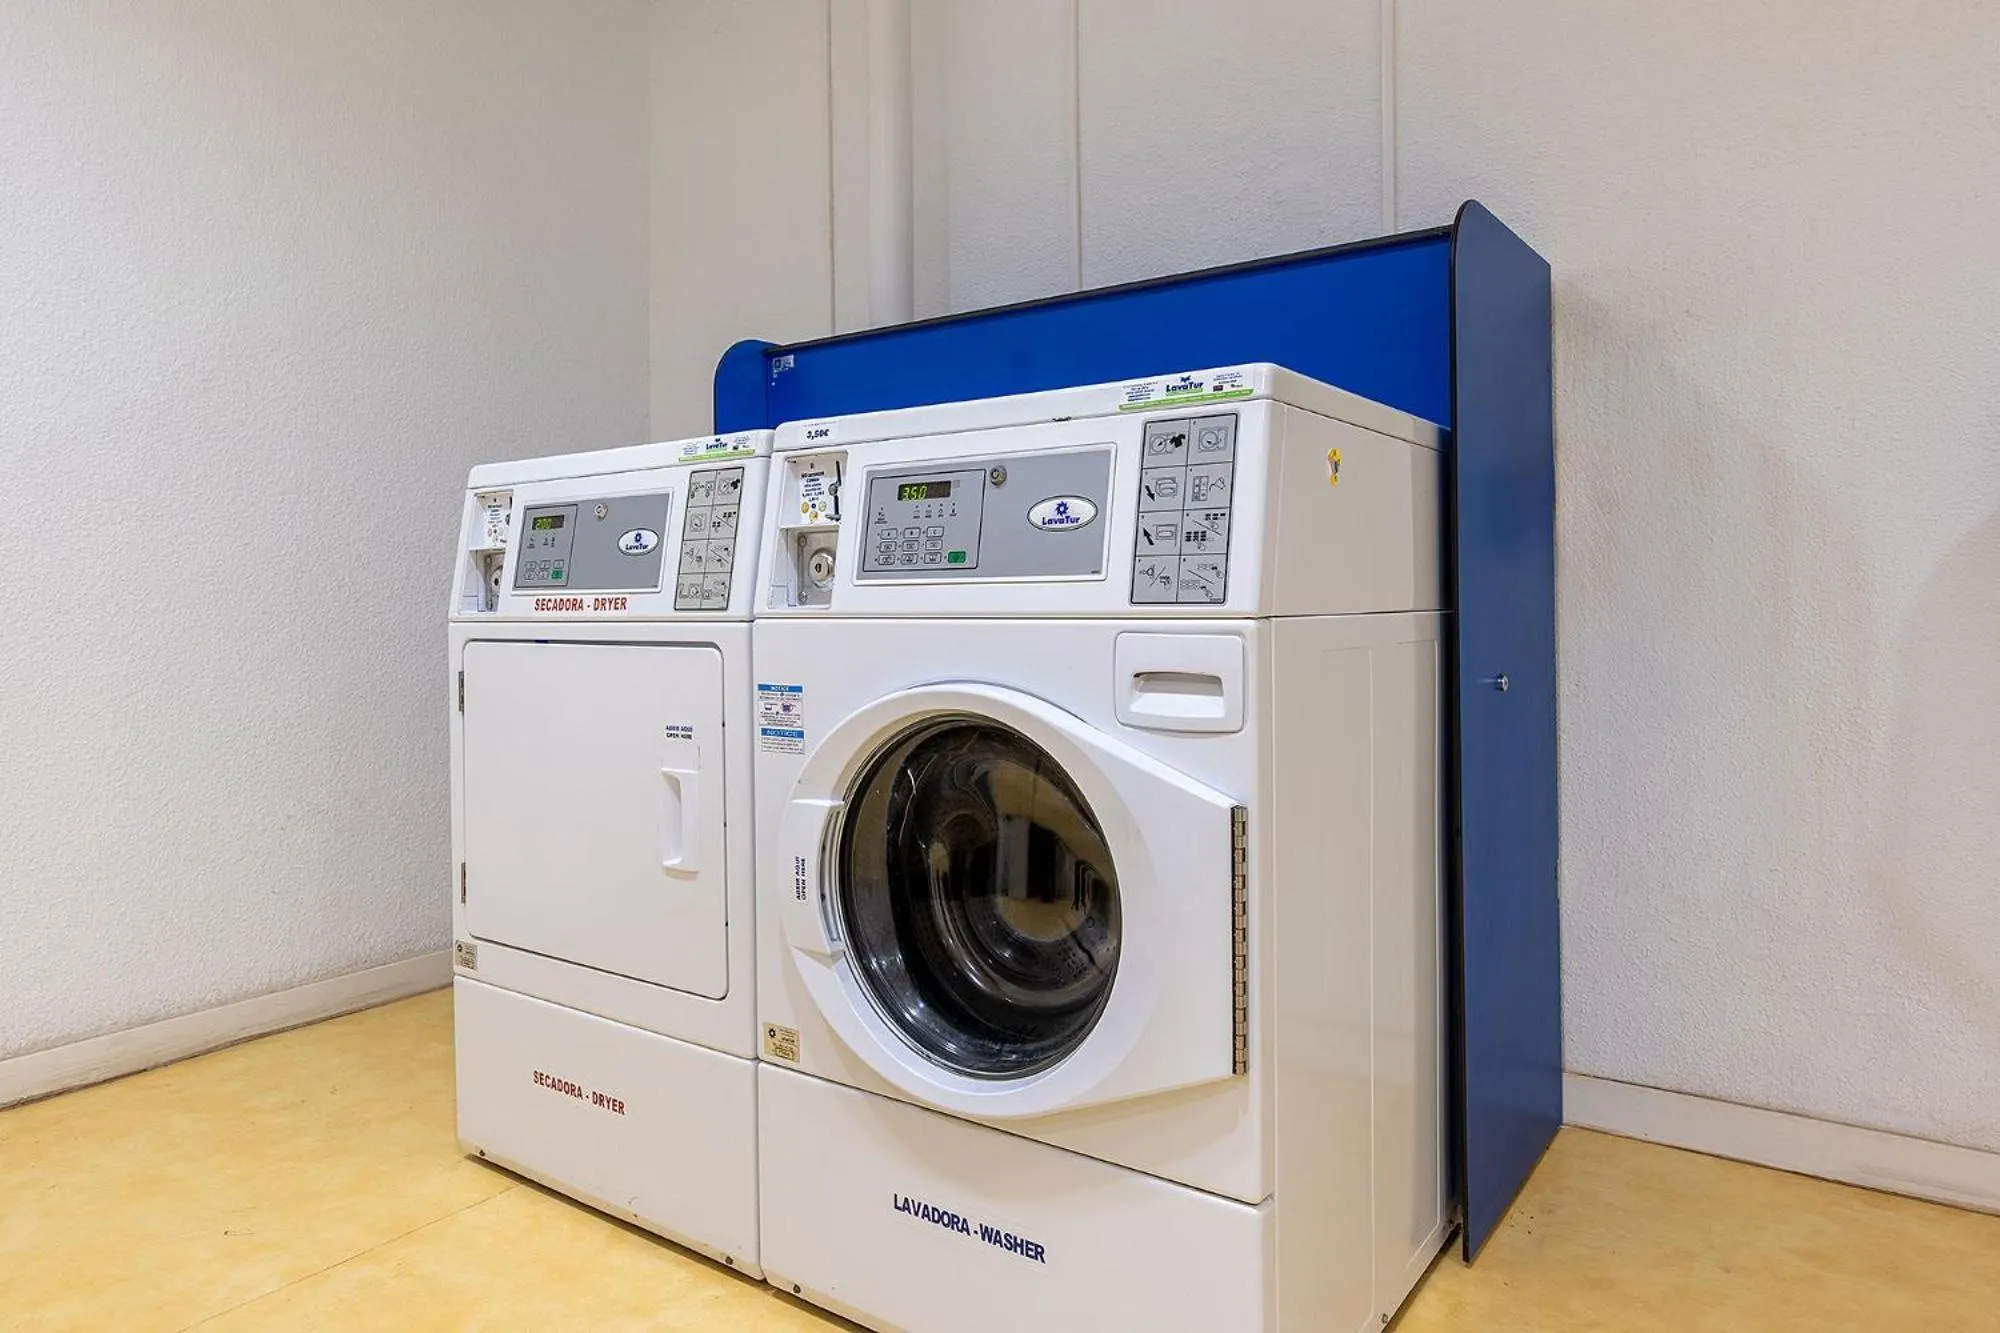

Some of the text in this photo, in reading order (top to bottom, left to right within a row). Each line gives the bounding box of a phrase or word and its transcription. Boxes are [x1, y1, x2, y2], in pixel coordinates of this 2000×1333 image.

[1166, 381, 1204, 393] LavaTur
[1042, 515, 1080, 525] LavaTur
[534, 598, 584, 611] SECADORA
[593, 597, 628, 611] DRYER
[766, 729, 796, 737] NOTICE
[533, 1070, 583, 1100] SECADORA
[592, 1091, 625, 1115] DRYER
[893, 1193, 971, 1236] LAVADORA
[979, 1223, 1046, 1264] WASHER
